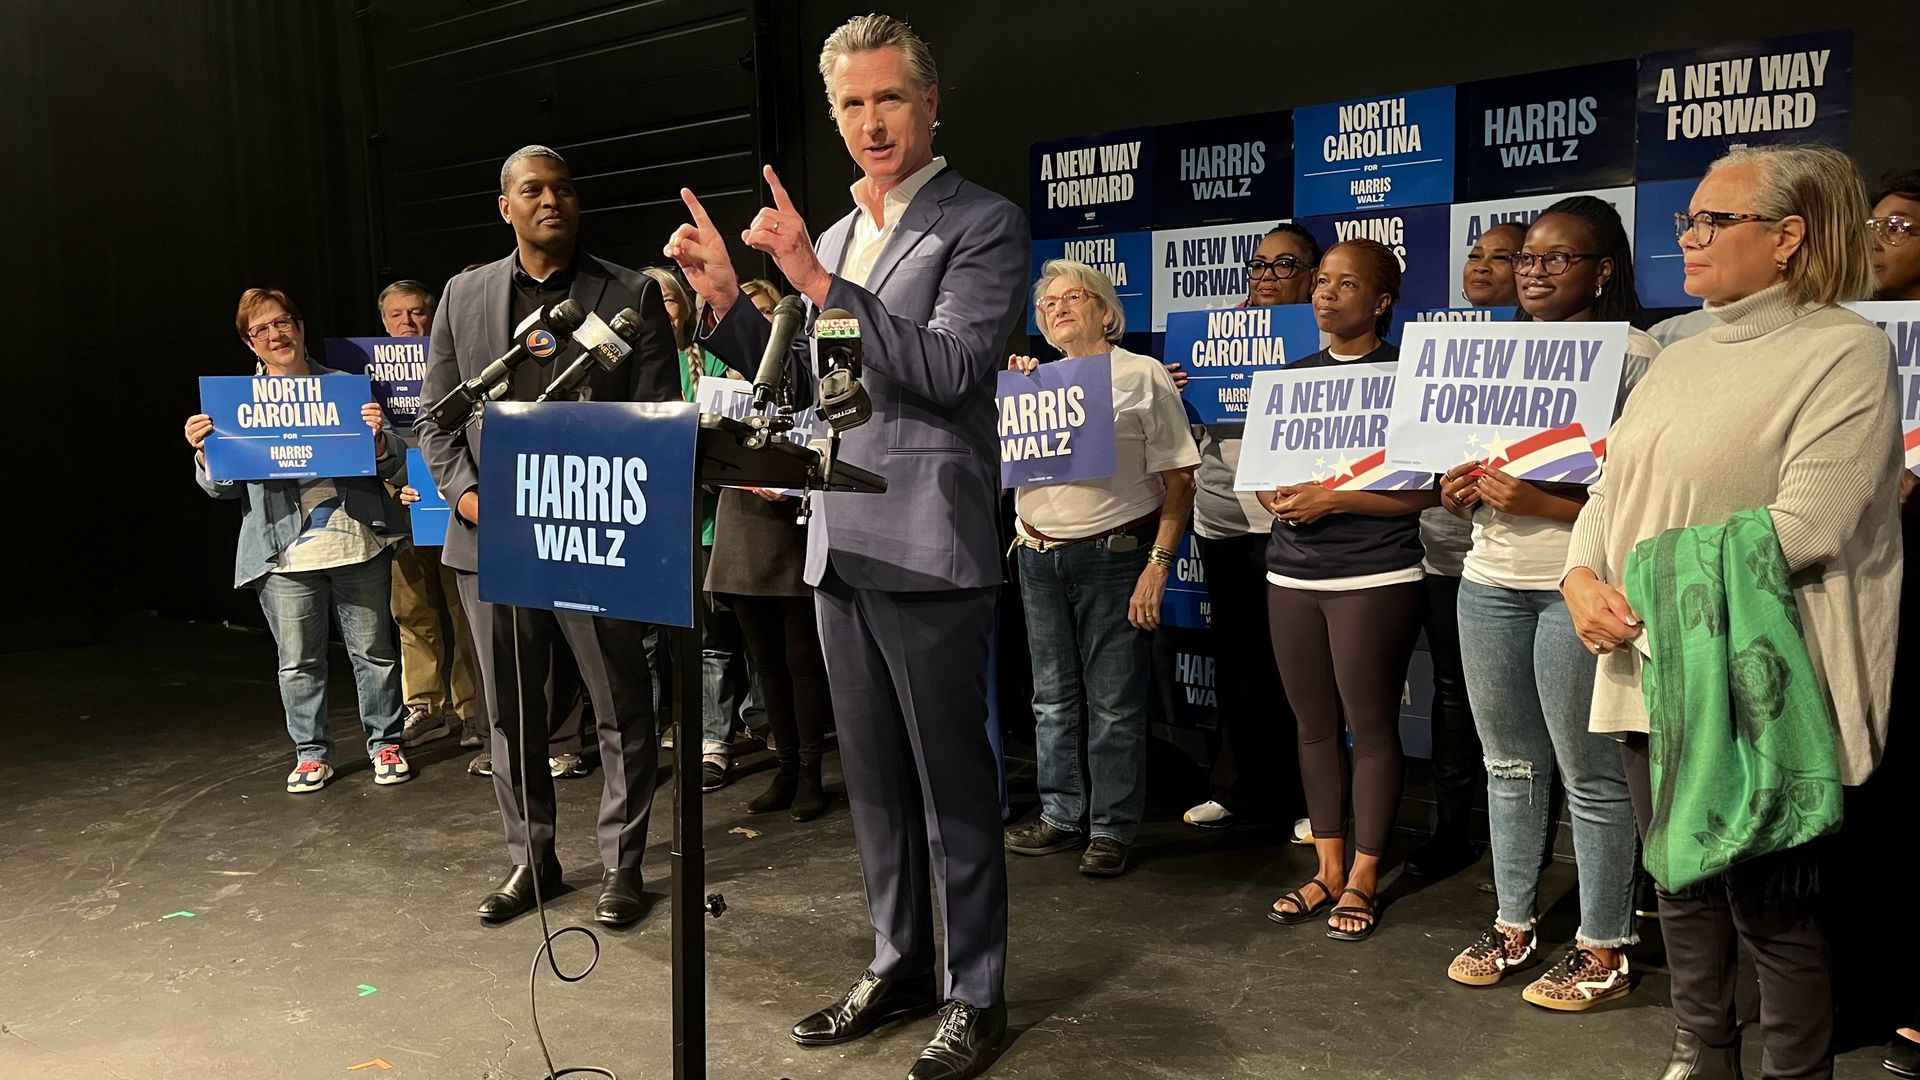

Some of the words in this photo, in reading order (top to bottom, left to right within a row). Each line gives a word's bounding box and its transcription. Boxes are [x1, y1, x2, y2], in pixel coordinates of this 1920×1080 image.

[1656, 68, 1677, 103] A
[1684, 58, 1753, 100] NEW
[1759, 50, 1830, 91] WAY
[1339, 98, 1405, 133] NORTH
[1484, 96, 1597, 146] HARRIS
[1667, 92, 1816, 140] FORWARD
[1323, 124, 1422, 162] CAROLINA
[1500, 139, 1578, 168] WALZ
[1041, 154, 1053, 181] A
[1056, 147, 1096, 179] NEW
[1099, 141, 1141, 173] WAY
[1181, 141, 1265, 181] HARRIS
[1364, 164, 1378, 172] FOR
[1048, 173, 1134, 209] FORWARD
[1192, 178, 1251, 200] WALZ
[1350, 177, 1391, 196] HARRIS
[1357, 193, 1385, 204] WALZ
[1335, 216, 1404, 246] YOUNG
[1467, 215, 1482, 246] A
[1064, 238, 1115, 264] NORTH
[1165, 241, 1177, 268] A
[1183, 237, 1227, 267] NEW
[1173, 267, 1250, 298] FORWAR
[816, 318, 859, 328] WCCB
[1208, 309, 1271, 339] NORTH
[373, 344, 425, 363] NORTH
[598, 341, 619, 363] NEWS
[608, 341, 624, 358] CITY
[1192, 337, 1286, 368] CAROLINA
[1415, 339, 1436, 378] A
[1442, 339, 1518, 379] NEW
[1523, 339, 1603, 382] WAY
[364, 362, 428, 382] CAROLIN
[252, 377, 322, 403] NORTH
[387, 396, 420, 408] HARRIS
[1219, 387, 1251, 403] HARRI
[1265, 383, 1284, 415] A
[1290, 378, 1355, 414] NEW
[237, 402, 340, 428] CAROLINA
[994, 385, 1086, 437] ARRIS
[1420, 383, 1577, 429] FORWARD
[1000, 431, 1072, 462] WALZ
[1270, 414, 1389, 451] FORWAR
[270, 445, 313, 460] HARRIS
[278, 459, 307, 468] WALZ
[516, 453, 647, 526] HARRIS
[533, 523, 626, 567] WALZ
[1175, 652, 1216, 688] HAR
[1186, 685, 1217, 708] WA
